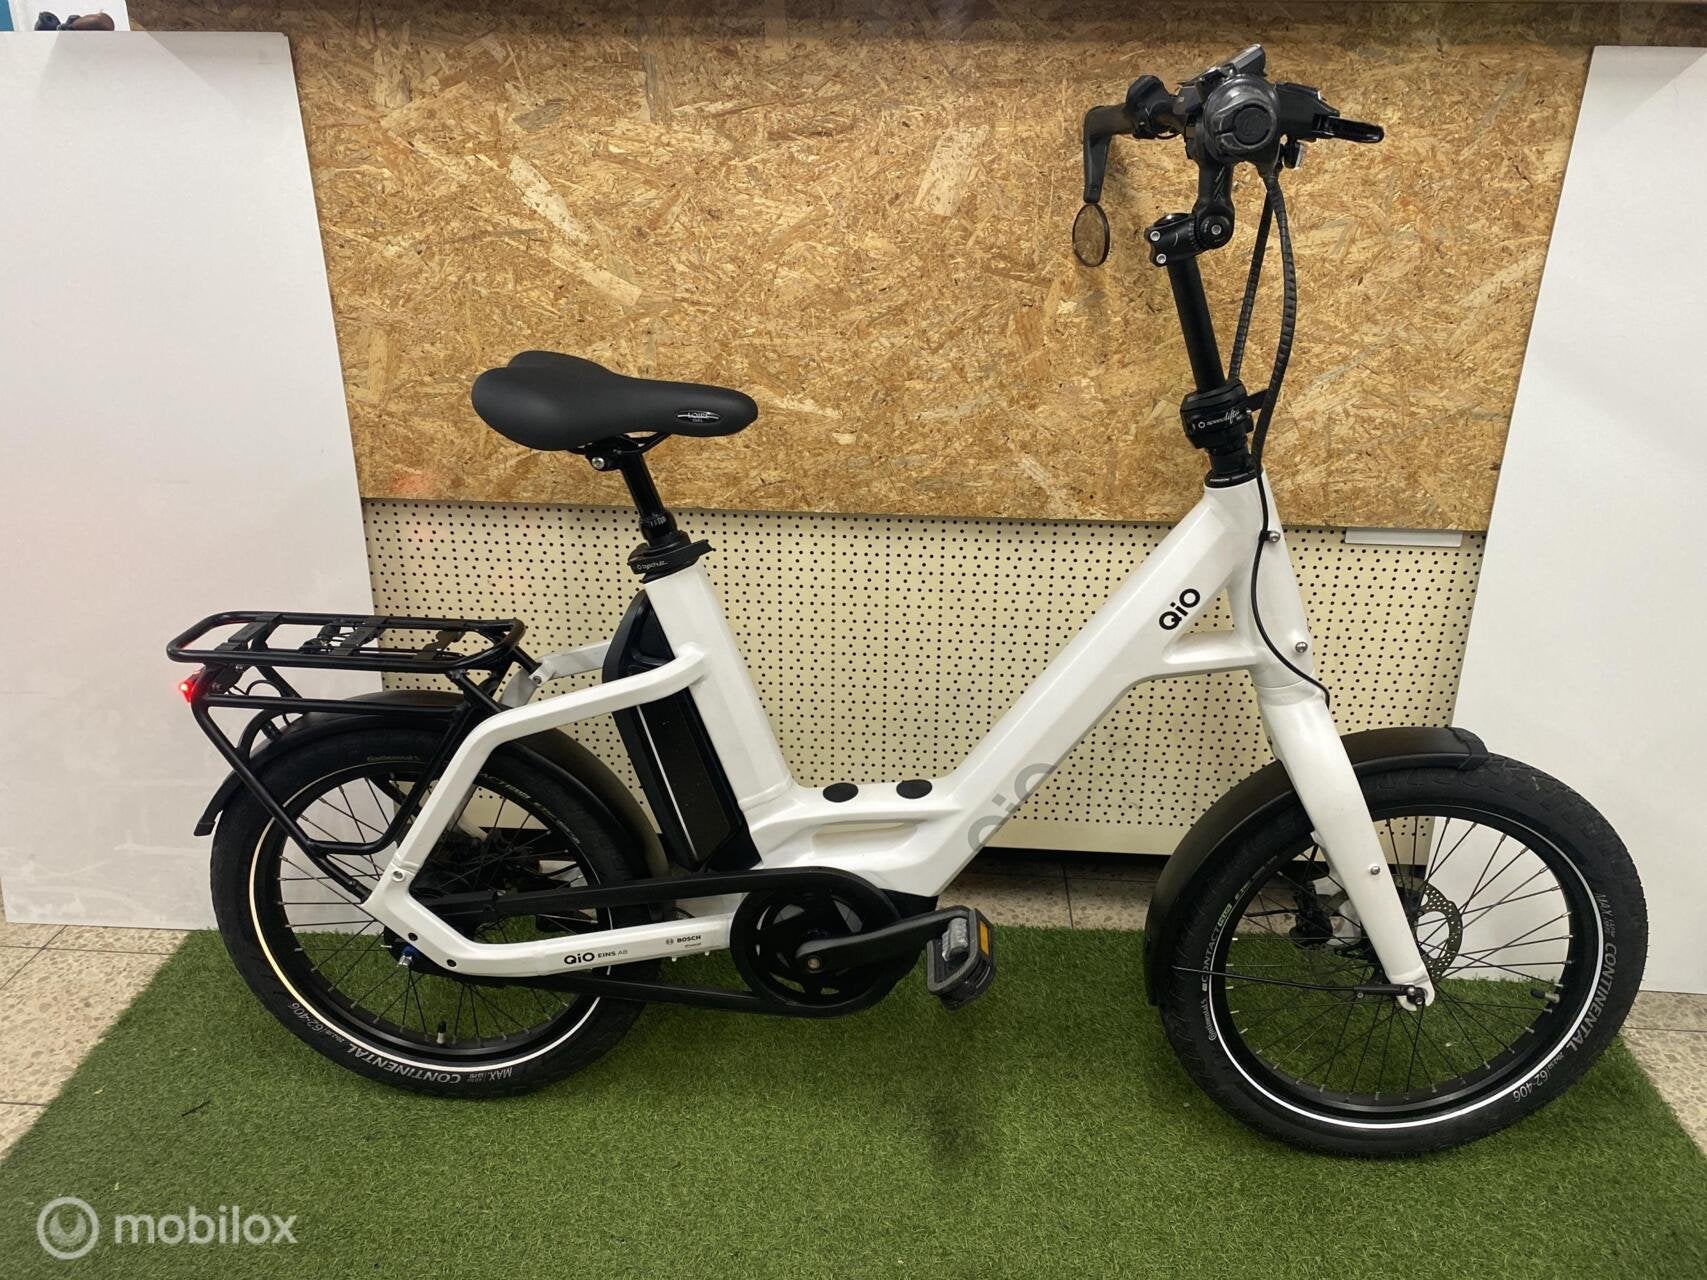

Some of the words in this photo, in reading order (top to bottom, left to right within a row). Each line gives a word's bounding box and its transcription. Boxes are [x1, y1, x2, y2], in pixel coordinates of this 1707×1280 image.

[1159, 588, 1201, 631] QiO
[563, 952, 595, 965] QiO
[597, 951, 616, 959] EINS
[676, 935, 702, 943] BOSCH
[1566, 942, 1617, 1052] CONTINENTAL
[347, 1043, 462, 1083] CONTINENTAL
